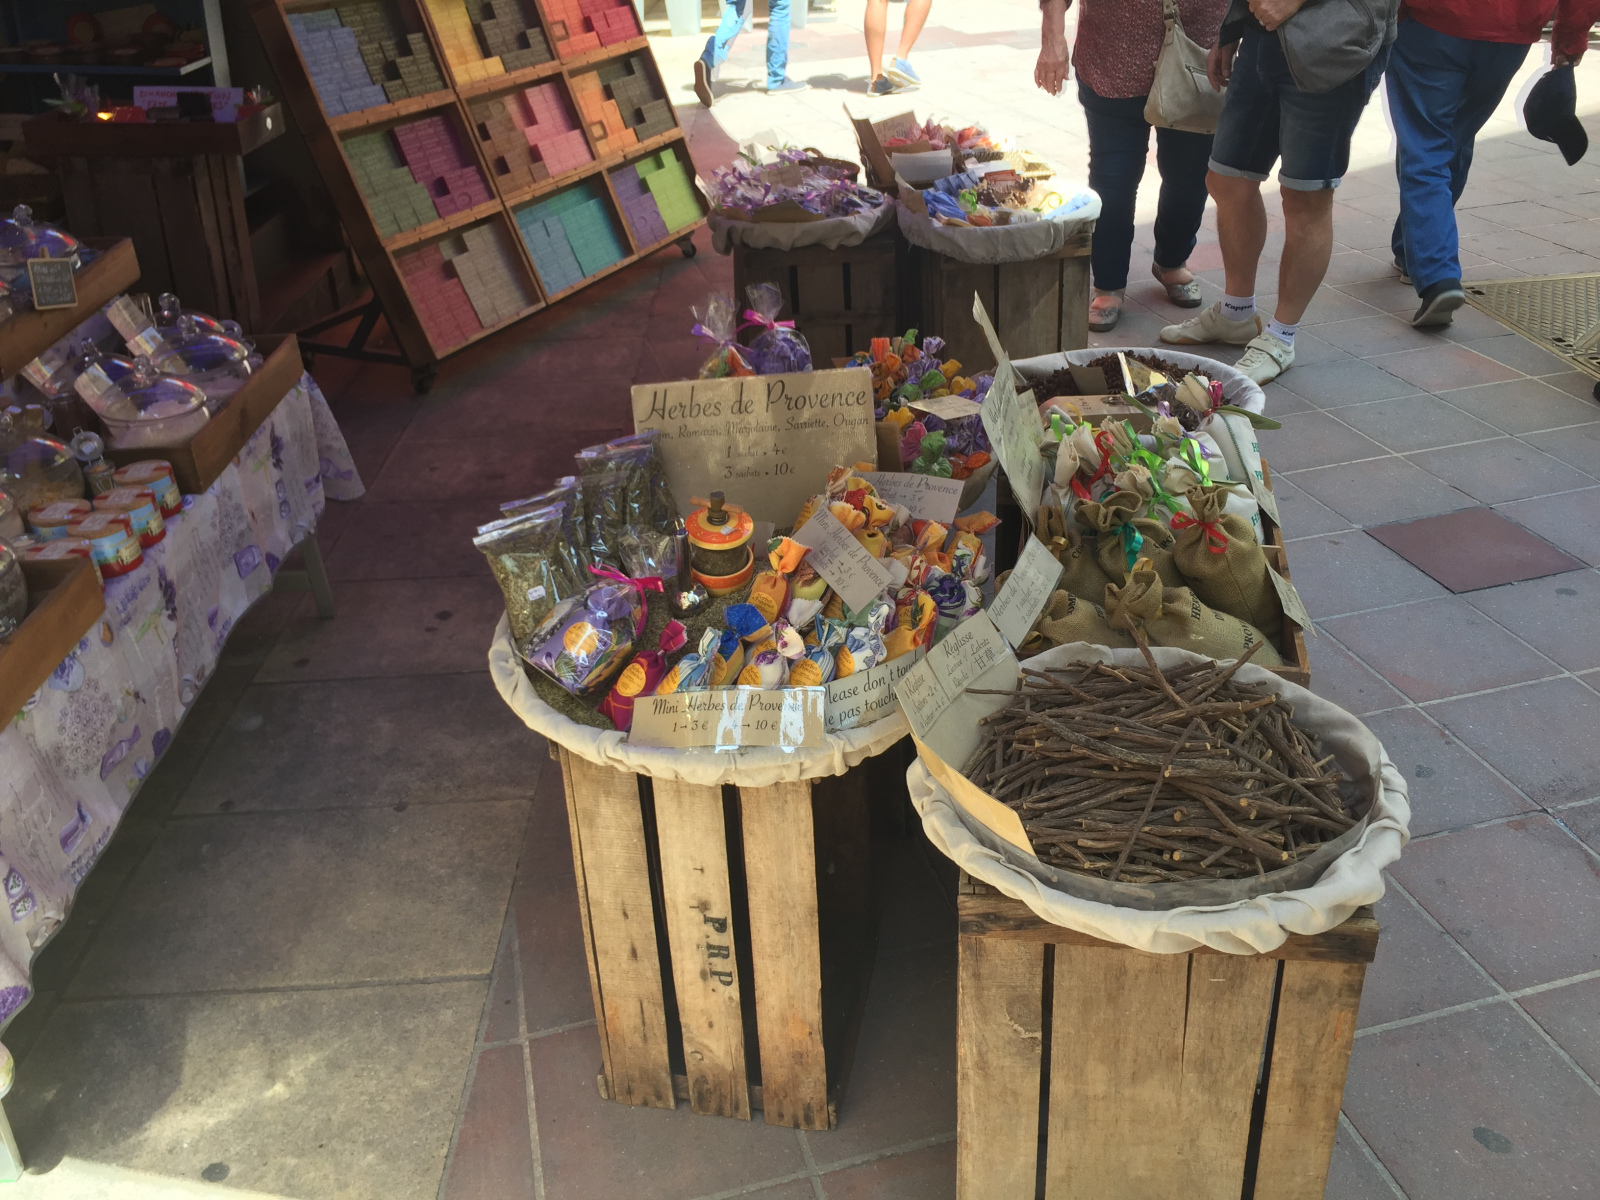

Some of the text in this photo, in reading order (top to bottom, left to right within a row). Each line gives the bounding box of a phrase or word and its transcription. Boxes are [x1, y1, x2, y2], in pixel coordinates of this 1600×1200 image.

[1224, 302, 1253, 312] Kappa
[639, 379, 867, 423] Herbes de Provence
[726, 445, 732, 459] 1
[724, 466, 733, 479] 3
[735, 467, 761, 478] sachets
[904, 475, 913, 489] de
[916, 476, 959, 495] Provence
[813, 508, 884, 587] Mini Herbes de Provence
[1006, 582, 1018, 598] de
[943, 631, 973, 658] Réglisse
[973, 647, 996, 670] 甘草
[824, 684, 860, 704] lease
[863, 664, 894, 693] don't
[652, 693, 803, 715] Mini Herbes de Provee
[839, 706, 861, 726] pas
[864, 683, 898, 712] touche
[691, 720, 698, 731] 3
[755, 719, 768, 731] 10
